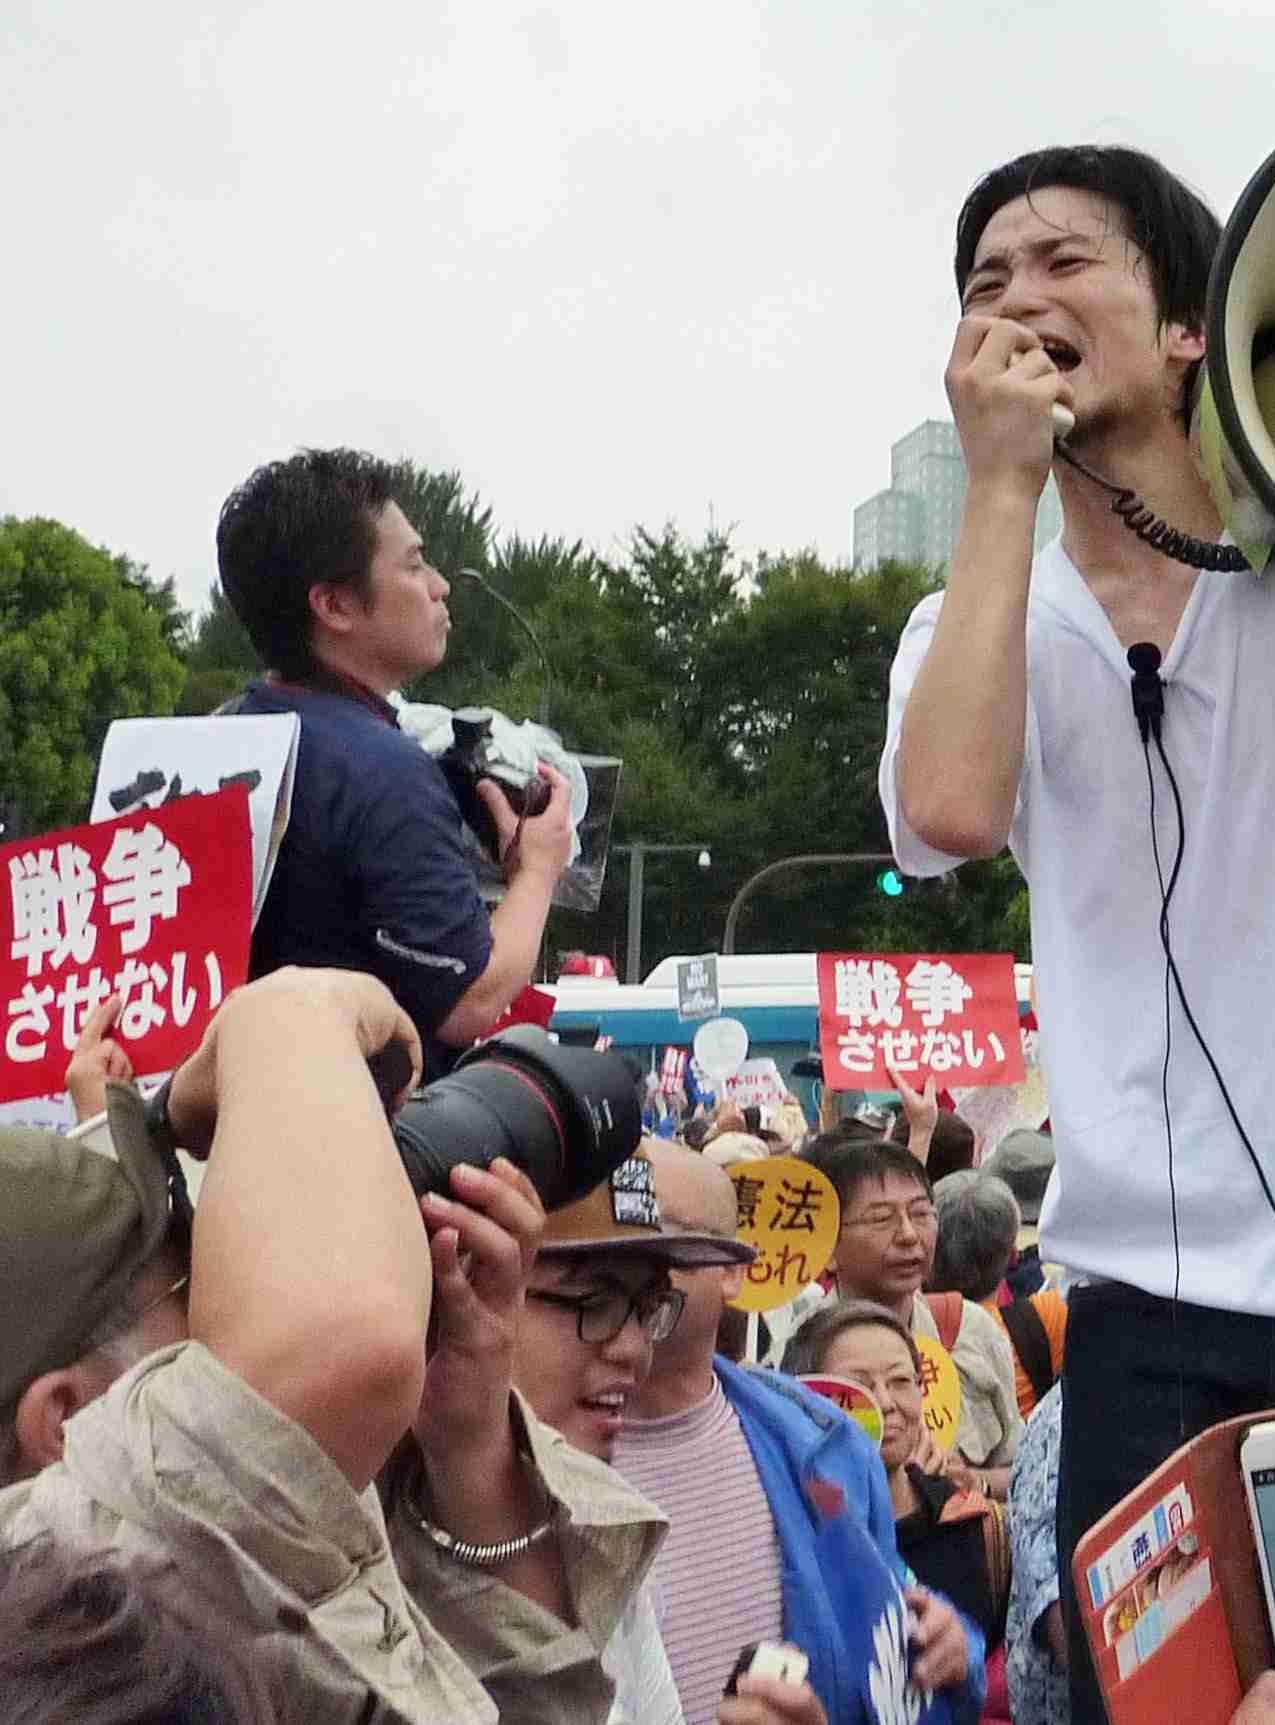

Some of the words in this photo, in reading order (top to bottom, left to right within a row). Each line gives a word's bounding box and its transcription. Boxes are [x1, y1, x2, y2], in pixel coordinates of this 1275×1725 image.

[7, 822, 191, 975] 戦争
[4, 951, 222, 1063] させない
[834, 959, 973, 1027] 戦争
[837, 1028, 1006, 1072] させない
